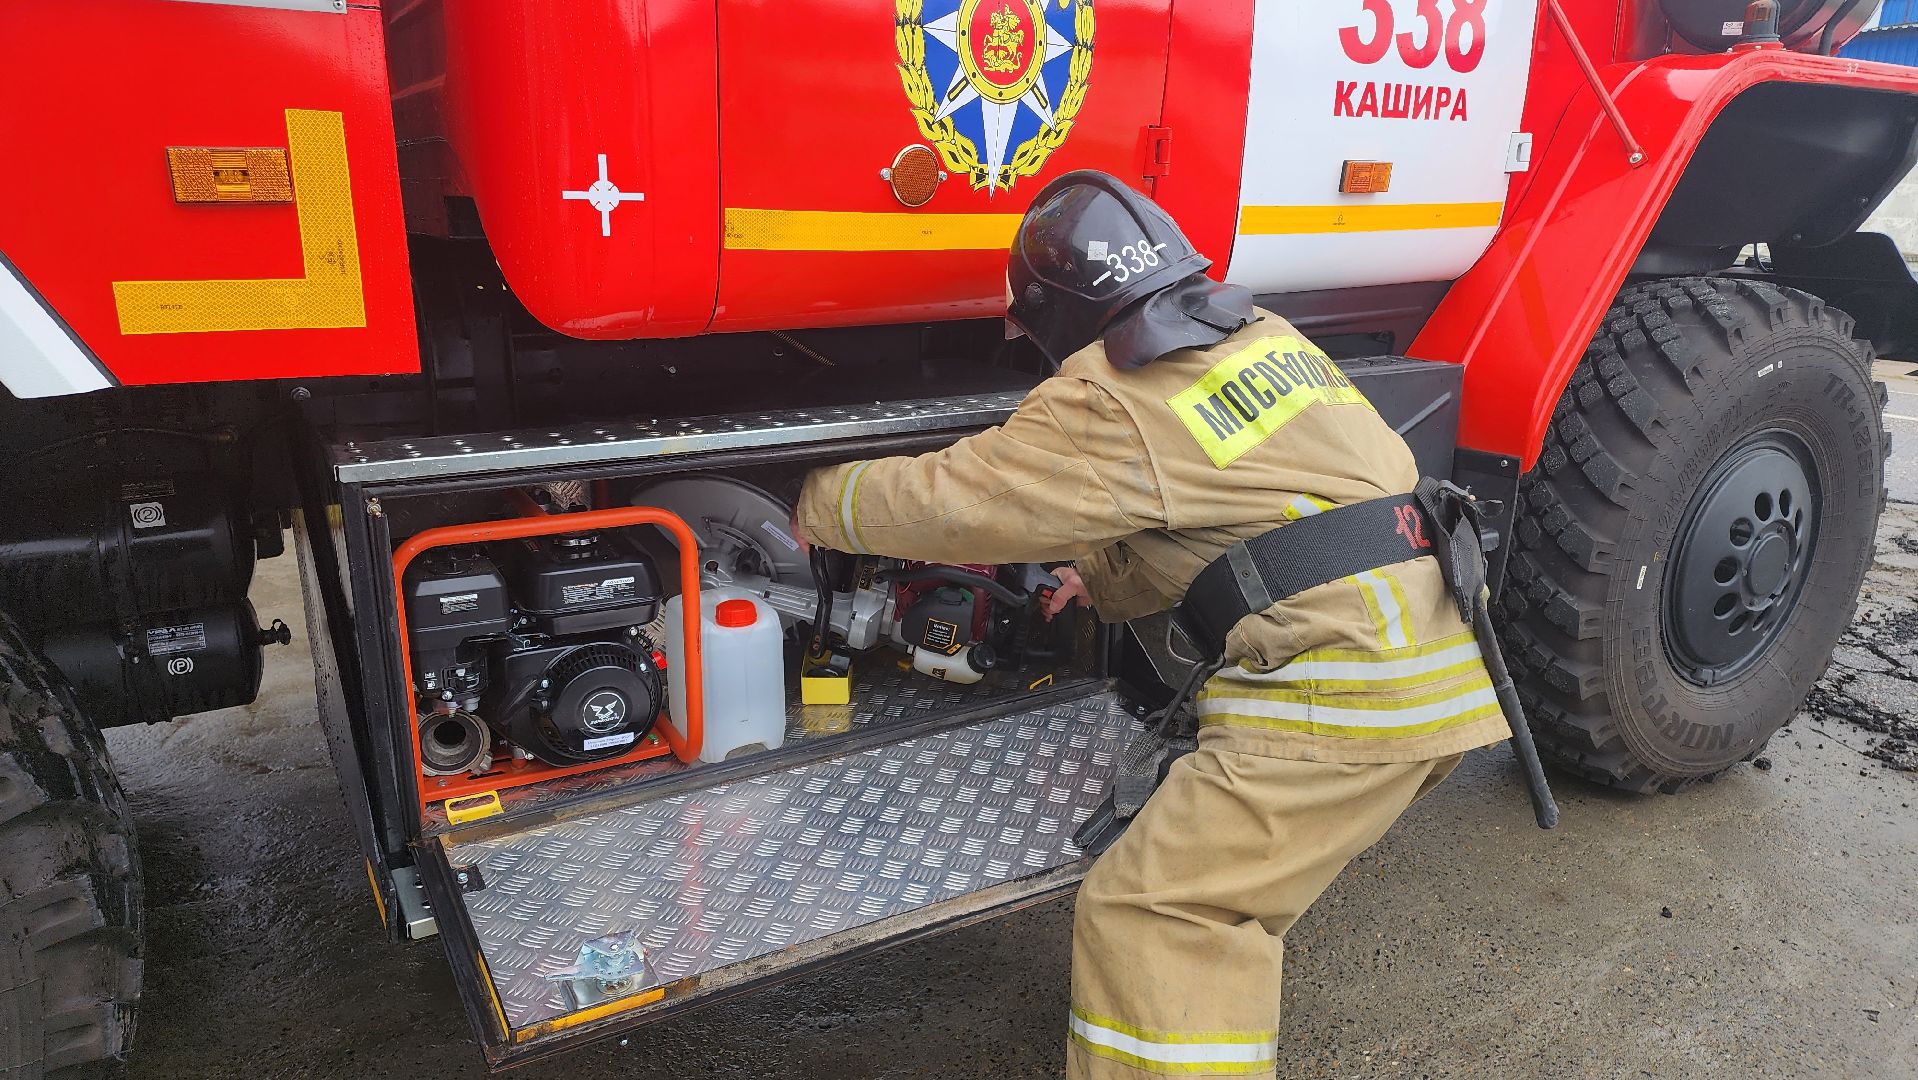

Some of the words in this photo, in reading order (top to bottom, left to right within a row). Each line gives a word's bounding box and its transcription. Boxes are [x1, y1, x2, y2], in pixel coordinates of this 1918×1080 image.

[1338, 0, 1488, 73] 338
[1333, 80, 1468, 122] КАШИРА
[1393, 504, 1431, 550] 12
